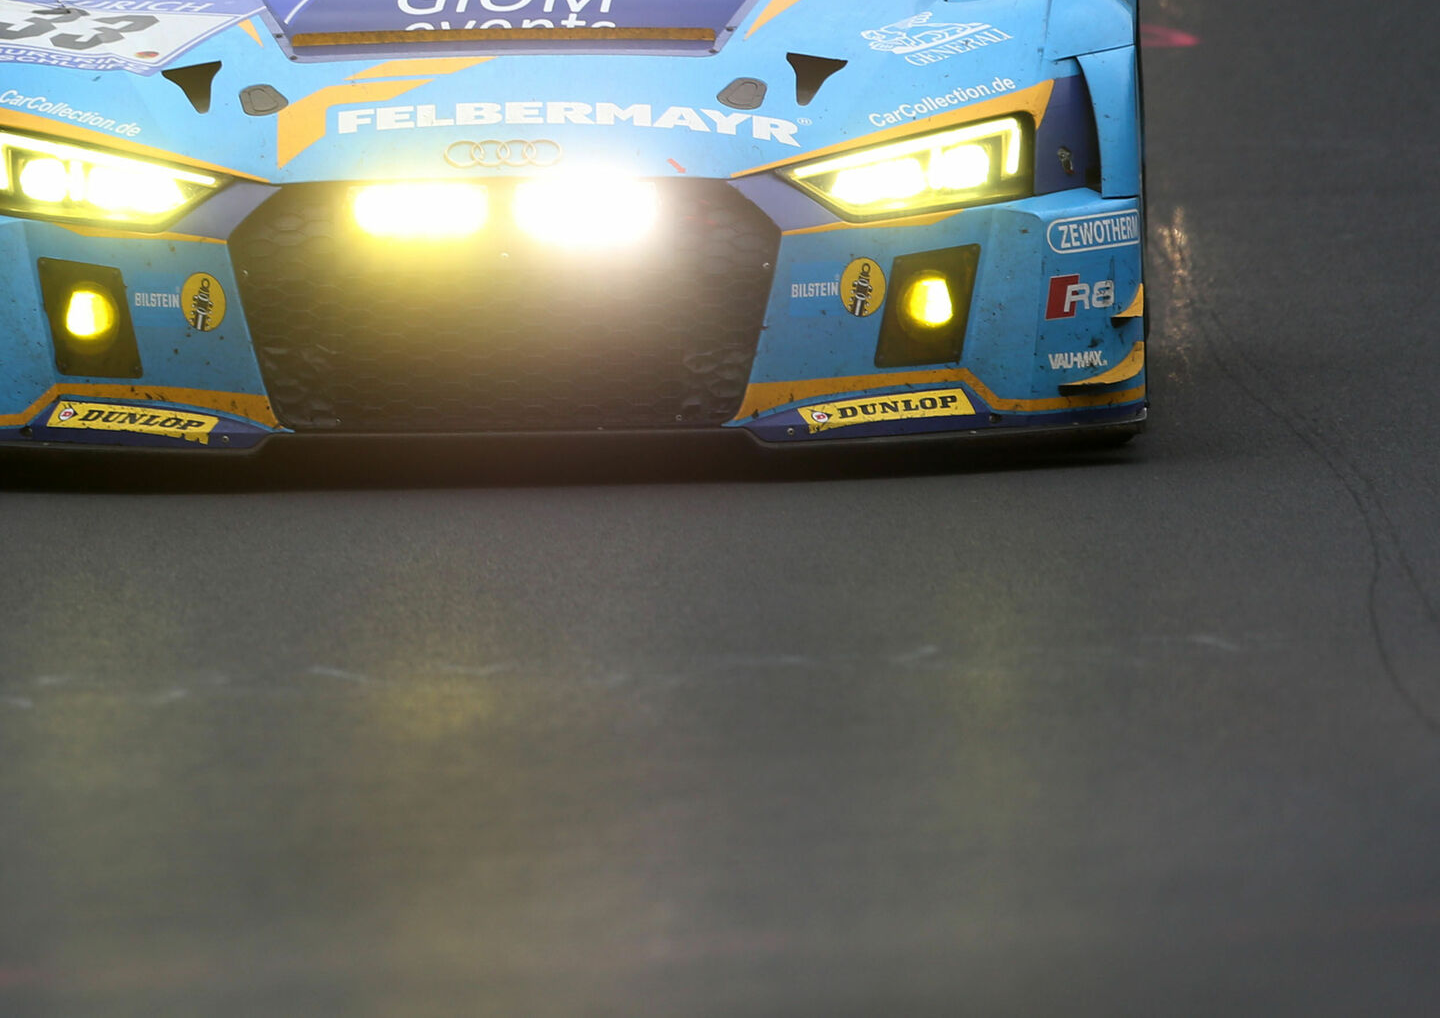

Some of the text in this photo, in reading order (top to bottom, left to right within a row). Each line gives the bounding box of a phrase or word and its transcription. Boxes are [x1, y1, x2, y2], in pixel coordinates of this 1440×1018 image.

[904, 27, 1015, 67] GENERALI
[868, 76, 1016, 128] CarCollection.de
[337, 101, 801, 149] FELBERMAYR
[1058, 214, 1139, 249] ZEWOTHERM
[134, 291, 180, 309] BILSTEIN
[791, 282, 839, 299] BILSTEIN
[1063, 279, 1115, 313] R8
[77, 408, 207, 431] DUNLOP
[838, 395, 958, 419] DUNLOP
